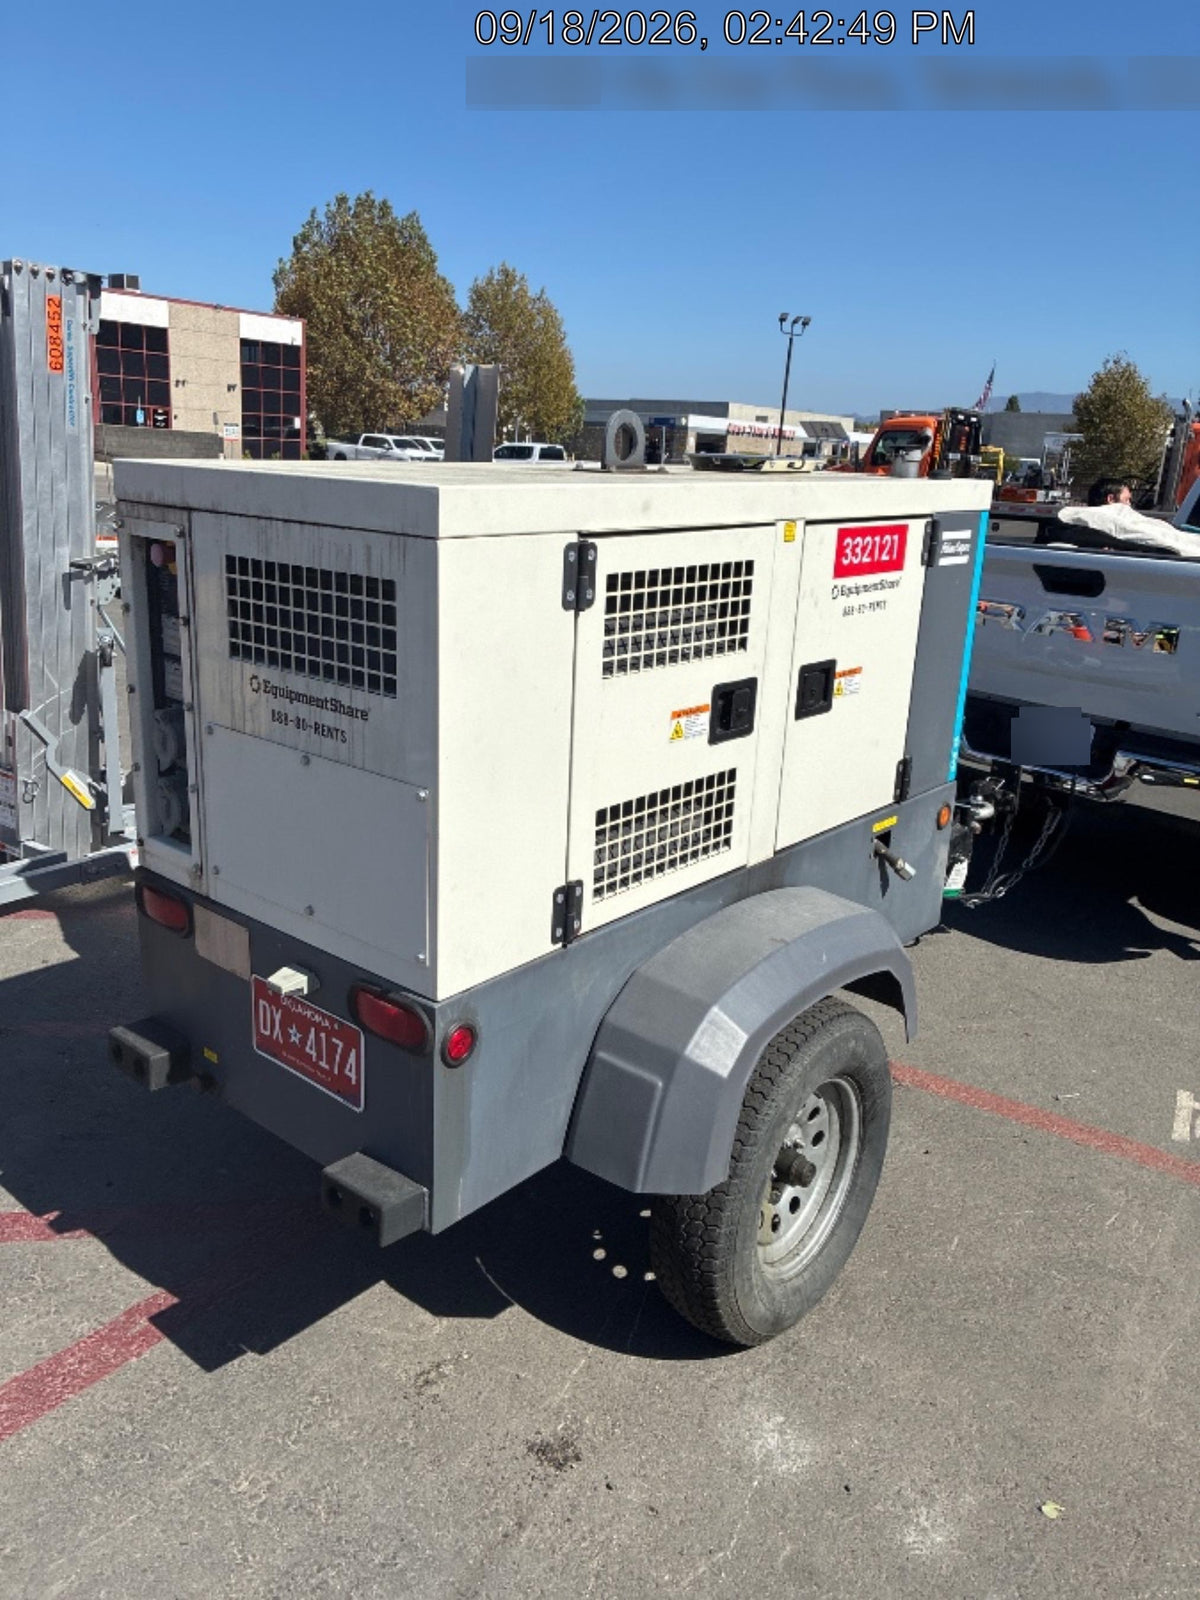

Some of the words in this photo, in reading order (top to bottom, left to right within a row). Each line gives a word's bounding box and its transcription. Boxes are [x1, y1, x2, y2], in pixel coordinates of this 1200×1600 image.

[48, 298, 63, 371] 608452
[841, 534, 900, 565] 332121
[976, 600, 1181, 654] RAM
[262, 679, 369, 721] EquipmentShare
[258, 998, 283, 1044] DX
[305, 1027, 357, 1085] 4174
